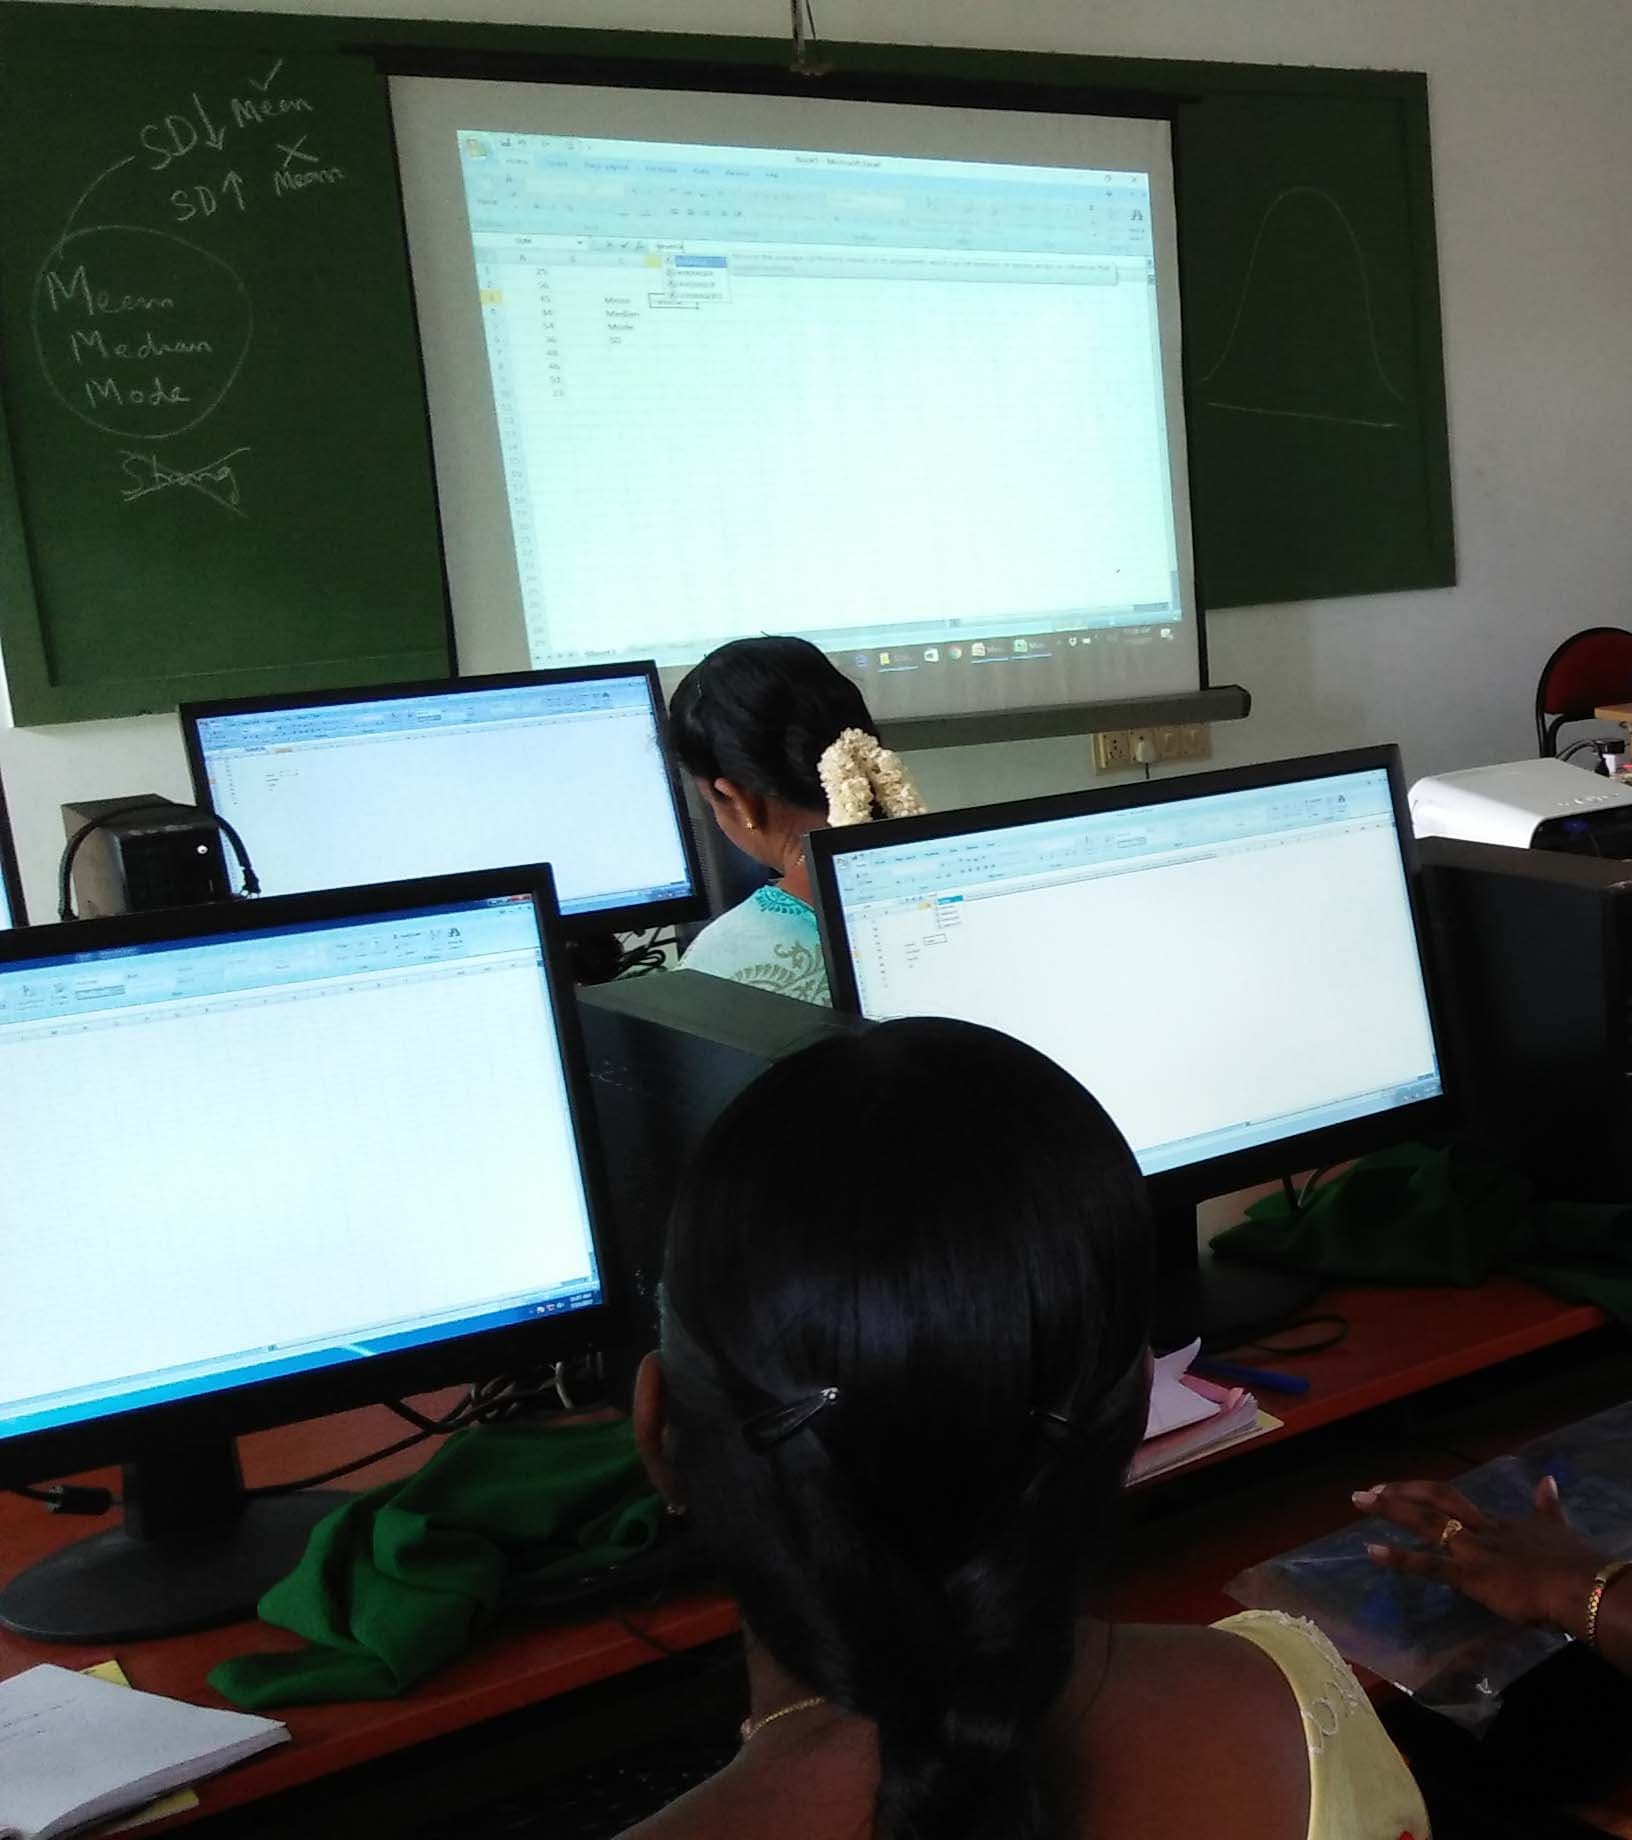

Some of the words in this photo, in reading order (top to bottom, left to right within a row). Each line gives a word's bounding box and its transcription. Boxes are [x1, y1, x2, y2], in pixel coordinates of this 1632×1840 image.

[139, 113, 198, 171] SD
[170, 185, 218, 221] SD
[85, 377, 190, 409] Mode
